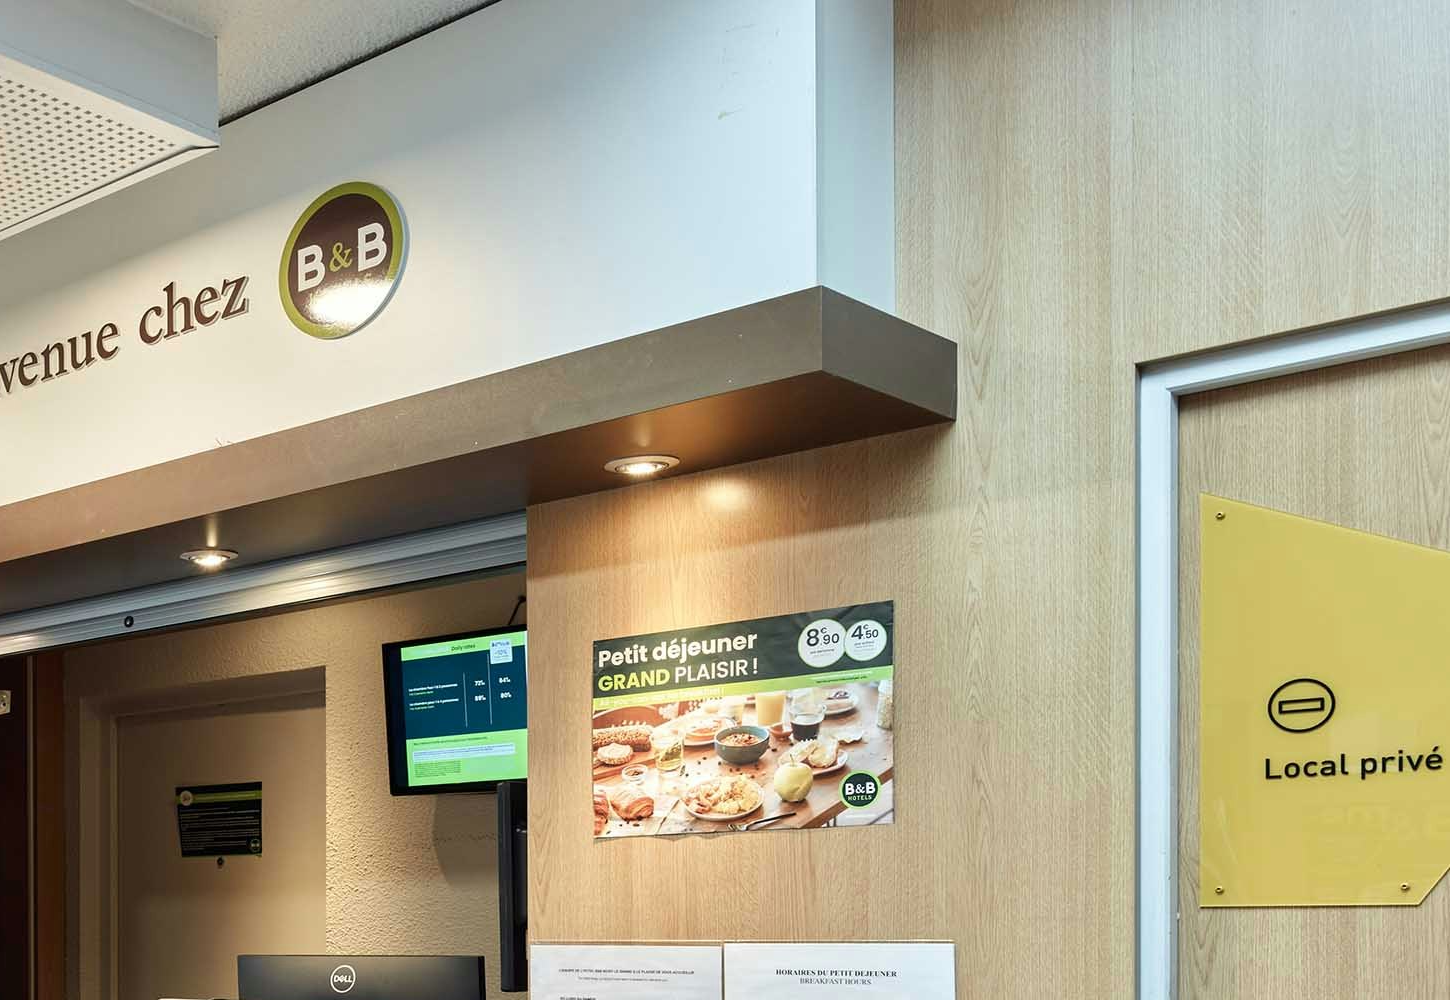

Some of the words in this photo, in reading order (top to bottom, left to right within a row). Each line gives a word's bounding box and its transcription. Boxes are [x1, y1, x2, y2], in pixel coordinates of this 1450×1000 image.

[138, 274, 250, 345] chez
[296, 222, 389, 293] B&B
[598, 644, 648, 668] Petit
[652, 633, 758, 664] déjeuner
[598, 668, 671, 692] GRAND
[674, 659, 748, 683] PLAISIR
[1264, 754, 1349, 780] Local
[1360, 746, 1443, 780] privé
[845, 782, 876, 795] B&B
[333, 975, 353, 983] DELL
[775, 968, 816, 976] HORAIRES
[817, 969, 828, 977] DU
[830, 969, 852, 977] PETIT
[799, 977, 843, 985] BREAKFAST
